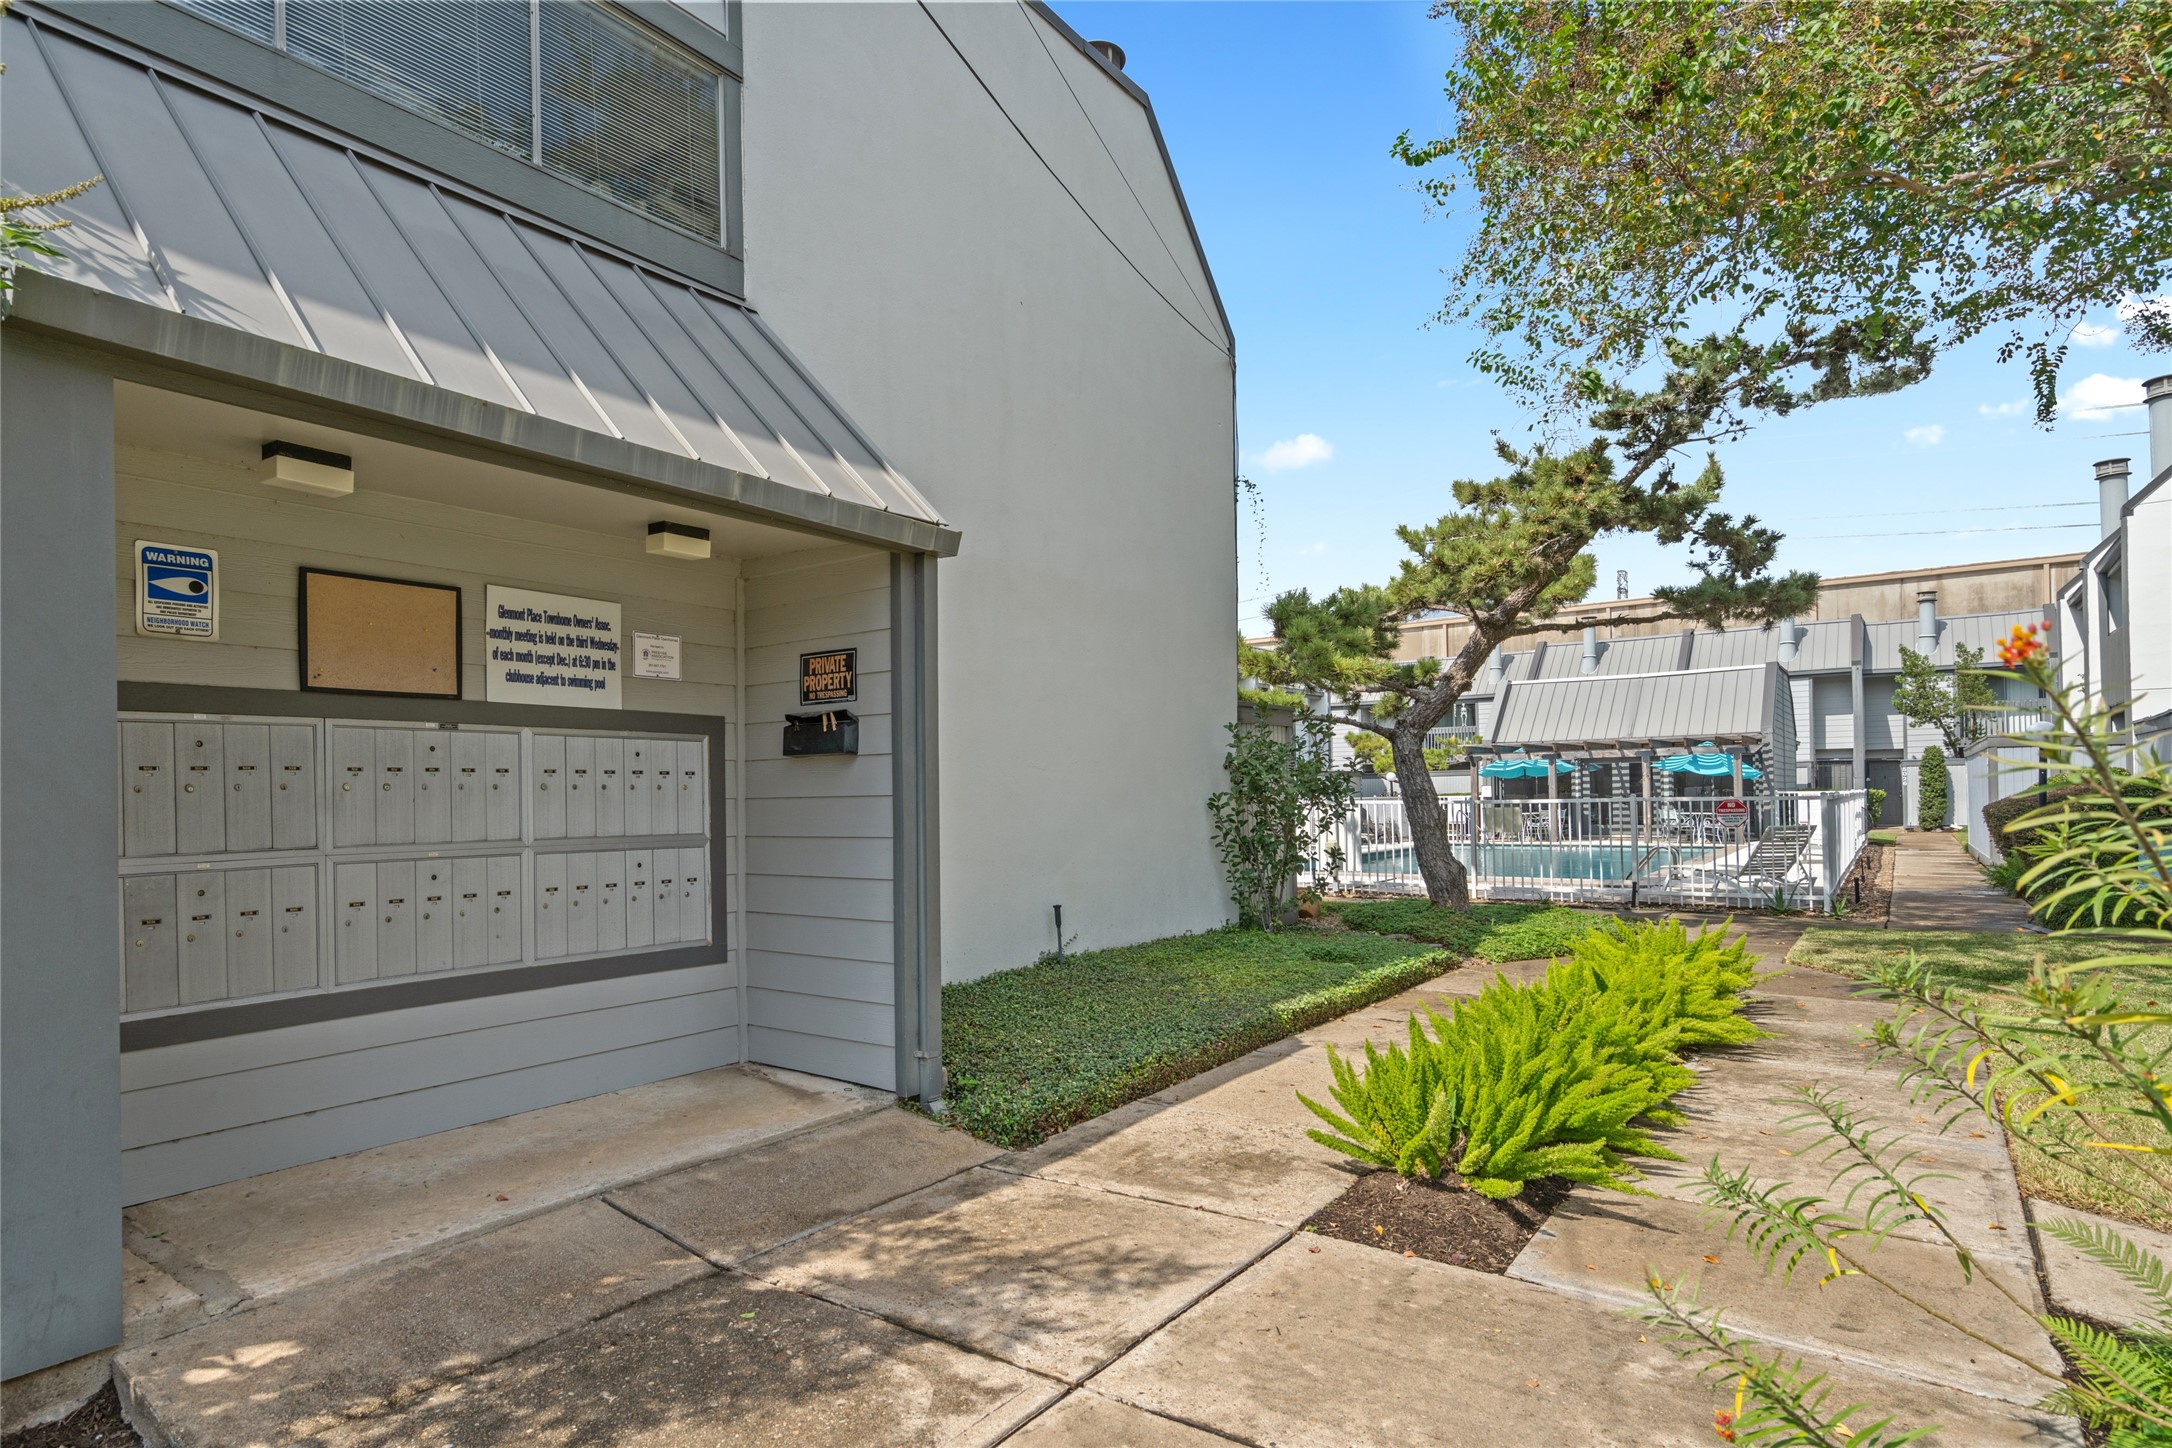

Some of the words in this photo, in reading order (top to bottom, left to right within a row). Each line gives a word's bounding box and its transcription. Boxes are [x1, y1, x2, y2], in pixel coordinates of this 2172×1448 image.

[146, 551, 209, 567] WARNING
[147, 617, 189, 626] NEIGHBORHOOD
[190, 620, 209, 628] WATCH
[498, 604, 525, 621] Glenmont
[527, 608, 542, 623] Place
[543, 610, 572, 627] Townhome
[573, 614, 594, 629] Owners'
[595, 617, 611, 631] Assoc.
[514, 628, 537, 645] meeting
[538, 630, 543, 644] is
[545, 631, 557, 645] held
[558, 635, 565, 646] on
[566, 633, 575, 647] the
[576, 635, 588, 649] third
[492, 646, 499, 660] of
[500, 648, 514, 661] each
[515, 650, 533, 663] month
[535, 651, 555, 667] (except
[556, 652, 570, 668] Dec.)
[572, 656, 578, 668] at
[579, 655, 591, 669] 6:30
[592, 659, 601, 671] pm
[601, 657, 607, 670] in
[608, 658, 616, 671] the
[810, 654, 847, 675] PRIVATE
[505, 669, 534, 684] clubhouse
[536, 671, 560, 687] adjacent
[561, 674, 566, 686] to
[568, 674, 593, 691] swimming
[594, 677, 606, 691] pool
[804, 671, 852, 692] PROPERTY
[809, 691, 816, 699] NO
[817, 690, 848, 699] TRESPASSING
